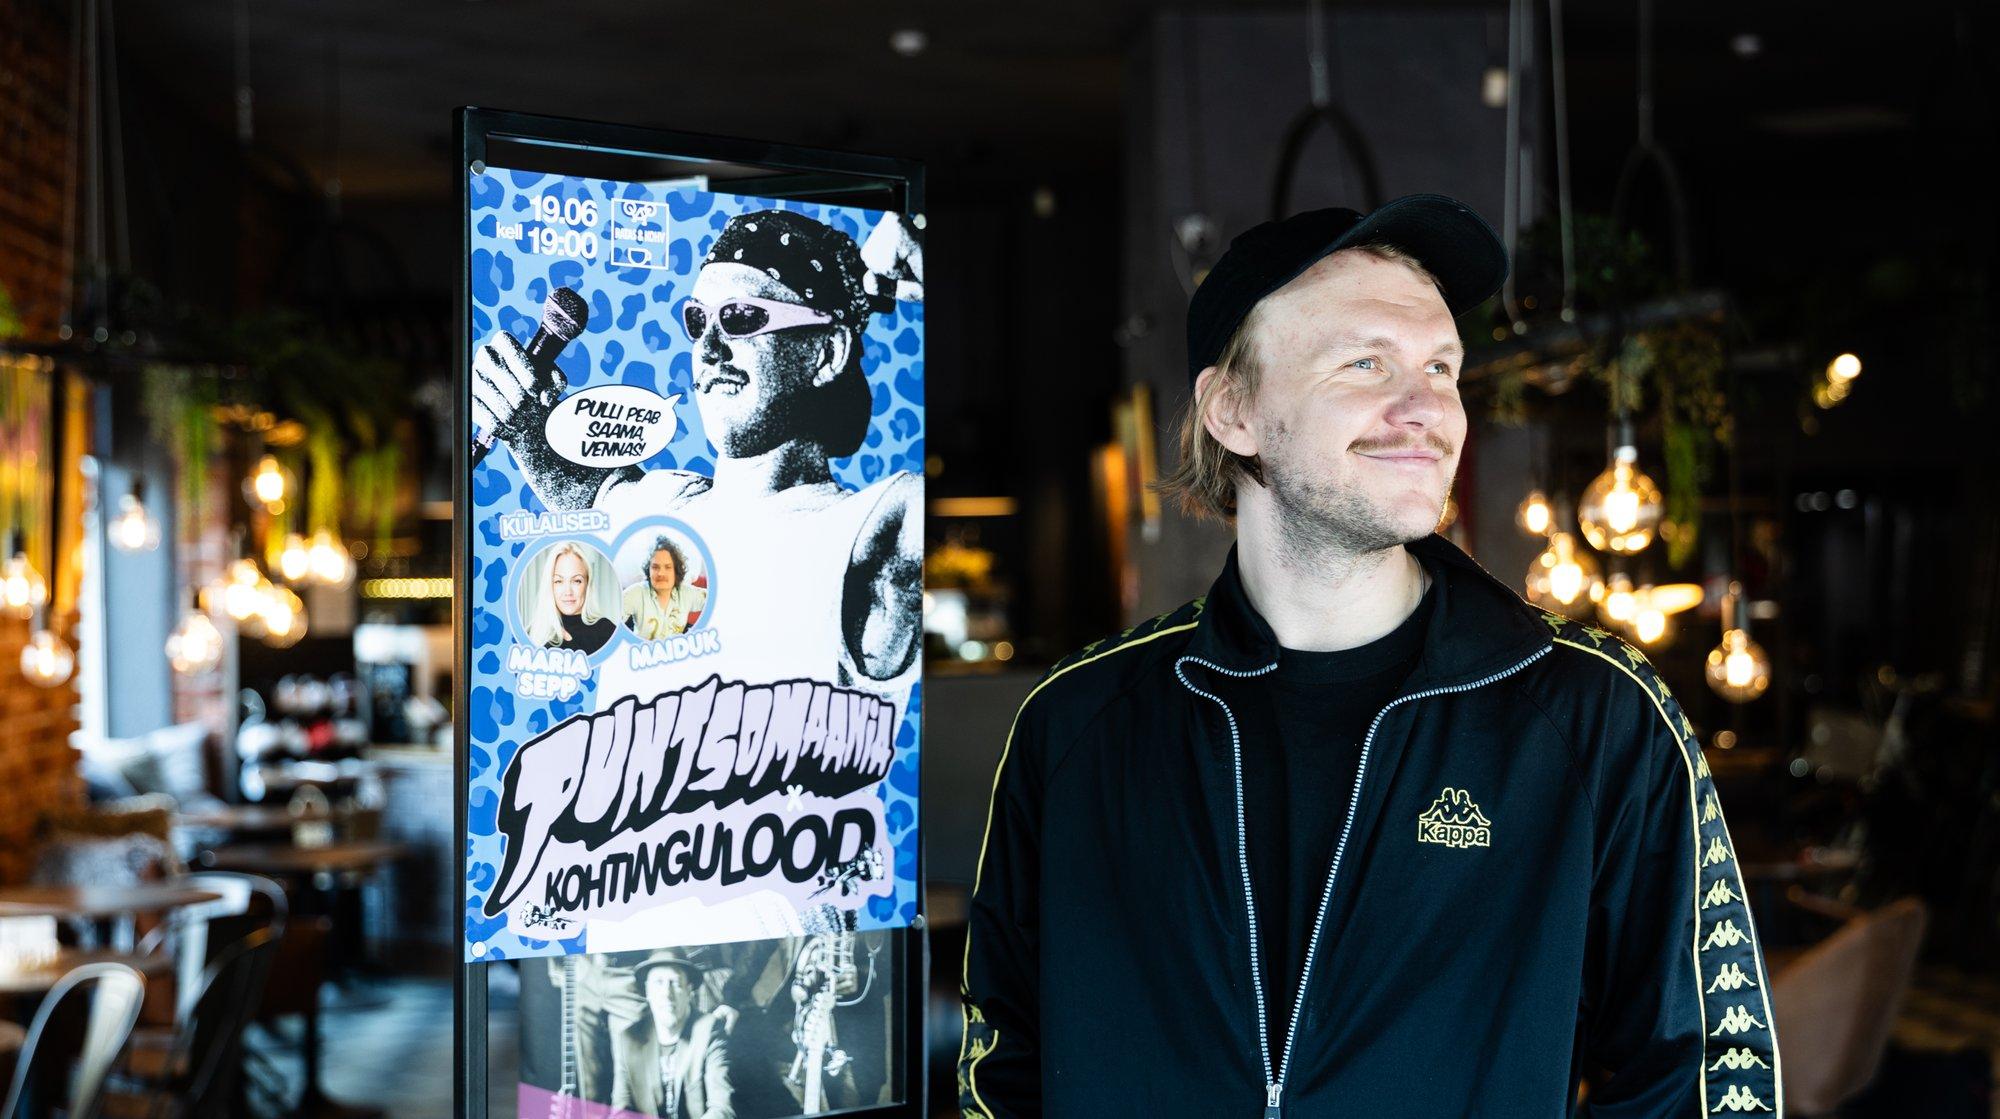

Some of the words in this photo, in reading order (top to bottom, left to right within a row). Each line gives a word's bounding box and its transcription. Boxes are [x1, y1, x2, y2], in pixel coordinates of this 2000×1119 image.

[530, 195, 598, 228] 19.06
[495, 221, 523, 241] kell
[528, 227, 598, 260] 19:00
[574, 398, 624, 420] PULLI
[625, 407, 662, 425] PEAB
[586, 421, 644, 442] SAAMA,
[581, 441, 646, 457] VENNAS!
[502, 511, 609, 537] KÜLALISED:
[509, 648, 589, 677] MARIA
[631, 631, 720, 669] MAIDUK
[518, 674, 577, 698] SEPP
[1418, 821, 1491, 848] Kappa
[544, 807, 877, 913] KOHTINGULOOD
